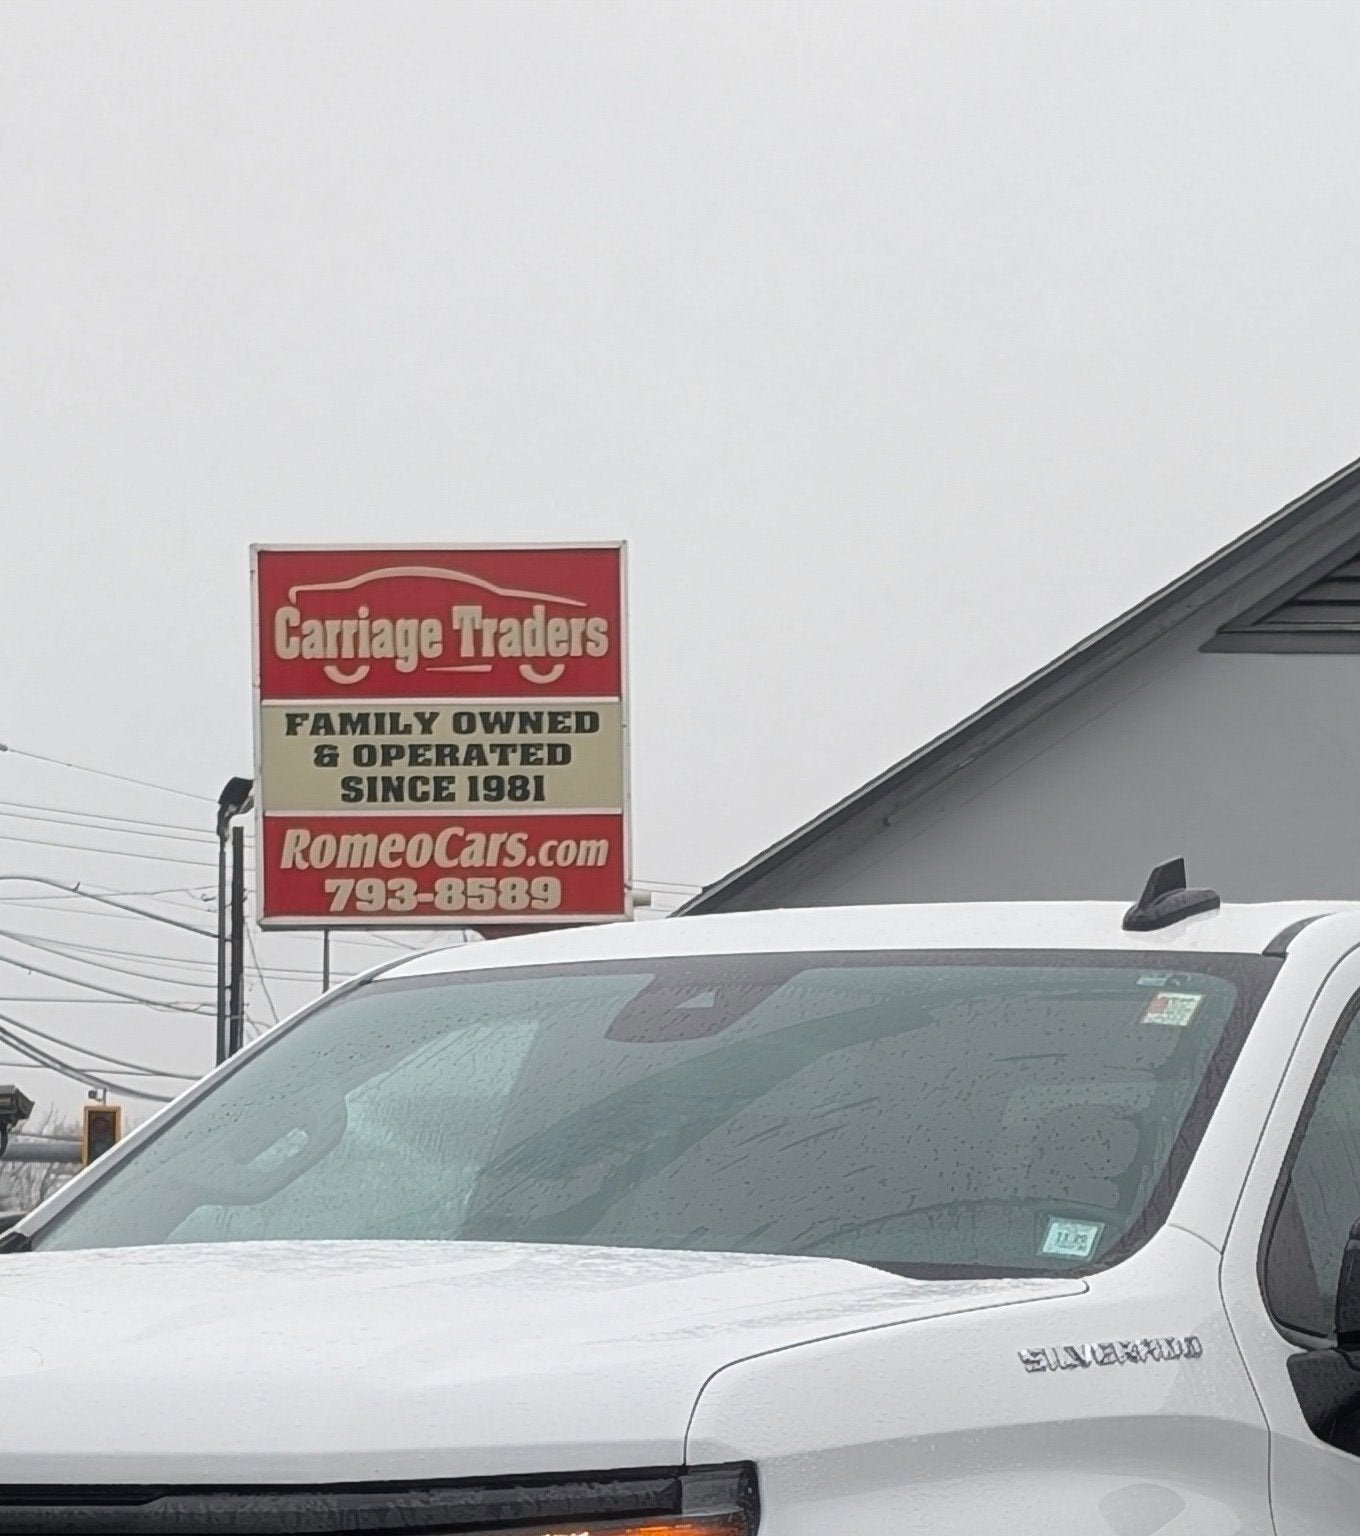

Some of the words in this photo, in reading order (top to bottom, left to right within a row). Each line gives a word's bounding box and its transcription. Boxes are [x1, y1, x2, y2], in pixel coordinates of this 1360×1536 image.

[275, 604, 443, 673] Carriage
[452, 604, 609, 659] Traders
[285, 711, 440, 737] FAMILY
[452, 710, 600, 736] OWNED
[313, 743, 340, 768] &
[353, 742, 572, 768] OPERATED
[340, 775, 456, 803] SINCE
[467, 774, 546, 803] 1981
[280, 826, 609, 870] RomeoCars.com
[324, 876, 562, 913] 793-8589
[1018, 1335, 1203, 1373] SILVERADO
